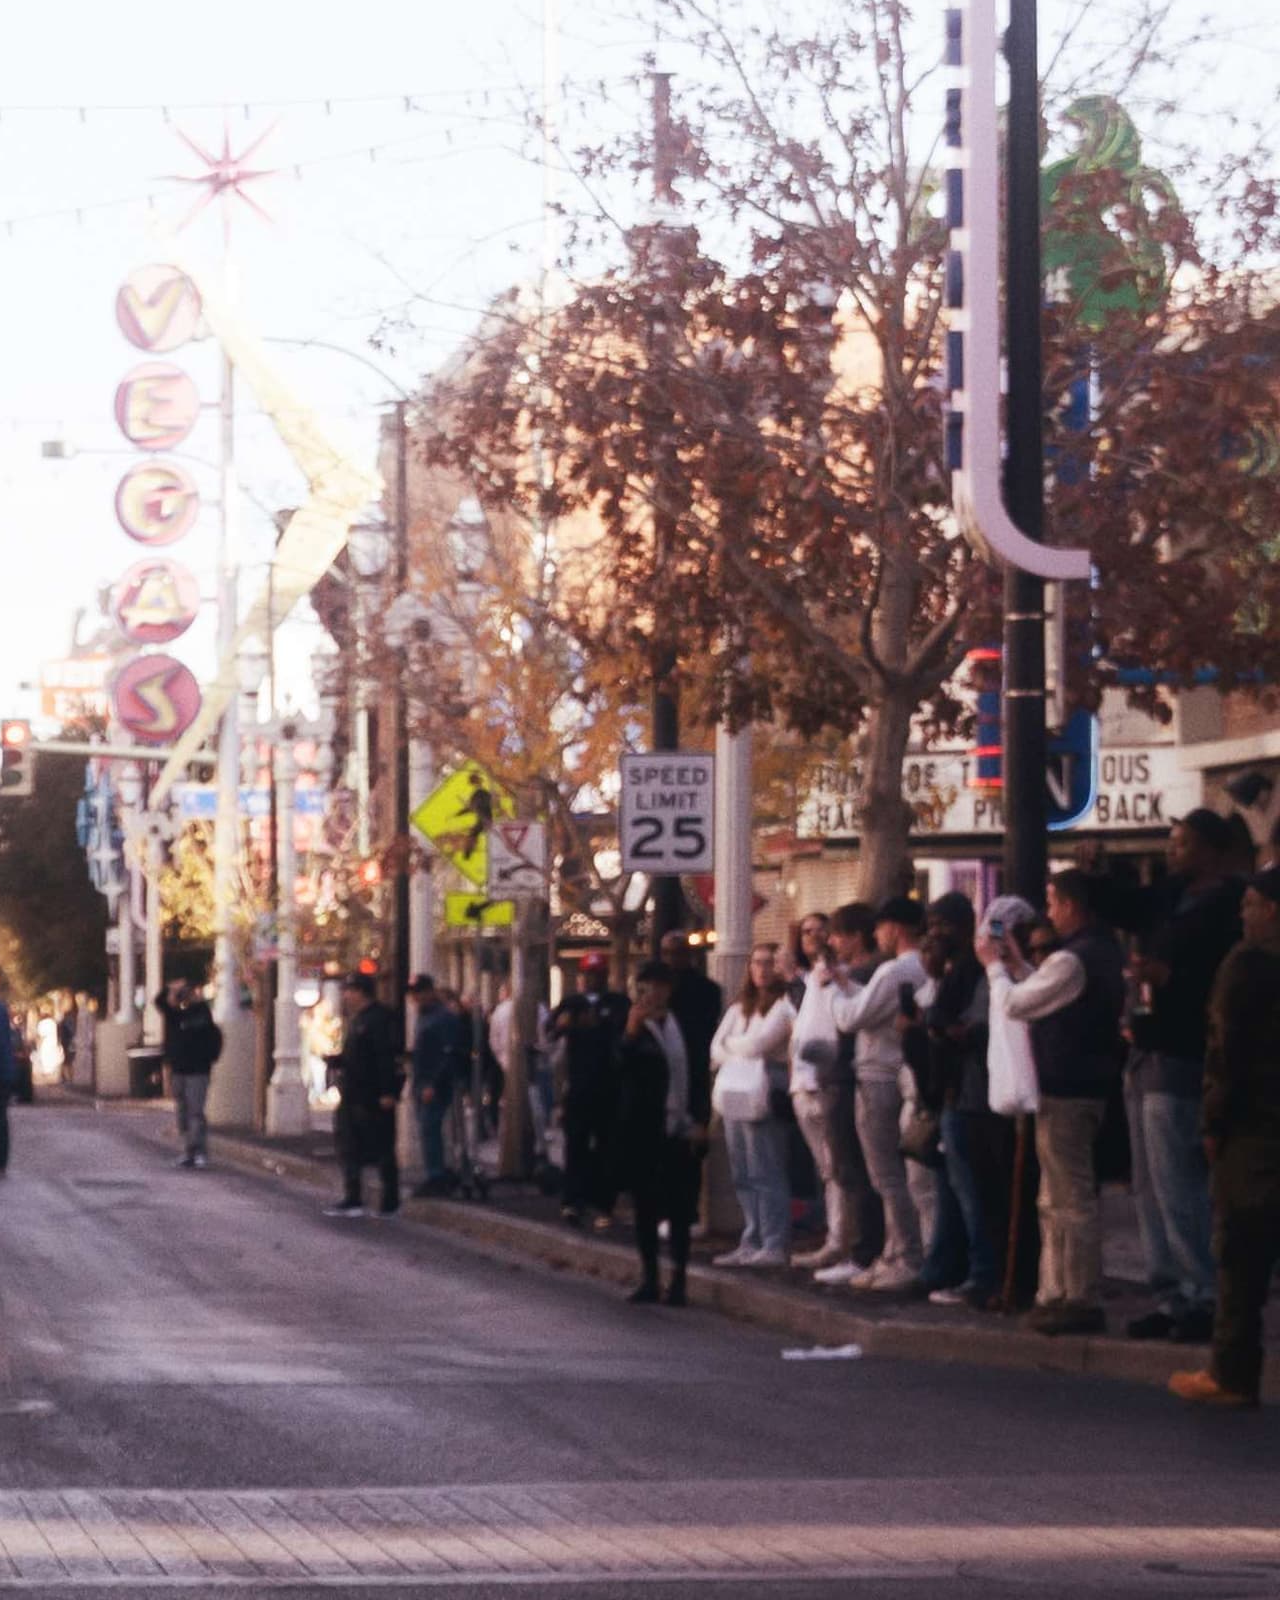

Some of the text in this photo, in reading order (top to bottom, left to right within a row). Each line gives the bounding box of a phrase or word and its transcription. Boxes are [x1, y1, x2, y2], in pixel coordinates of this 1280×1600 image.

[119, 270, 200, 734] VEGAS
[629, 765, 709, 786] SPEED
[636, 792, 698, 810] LIMIT
[630, 816, 706, 860] 25
